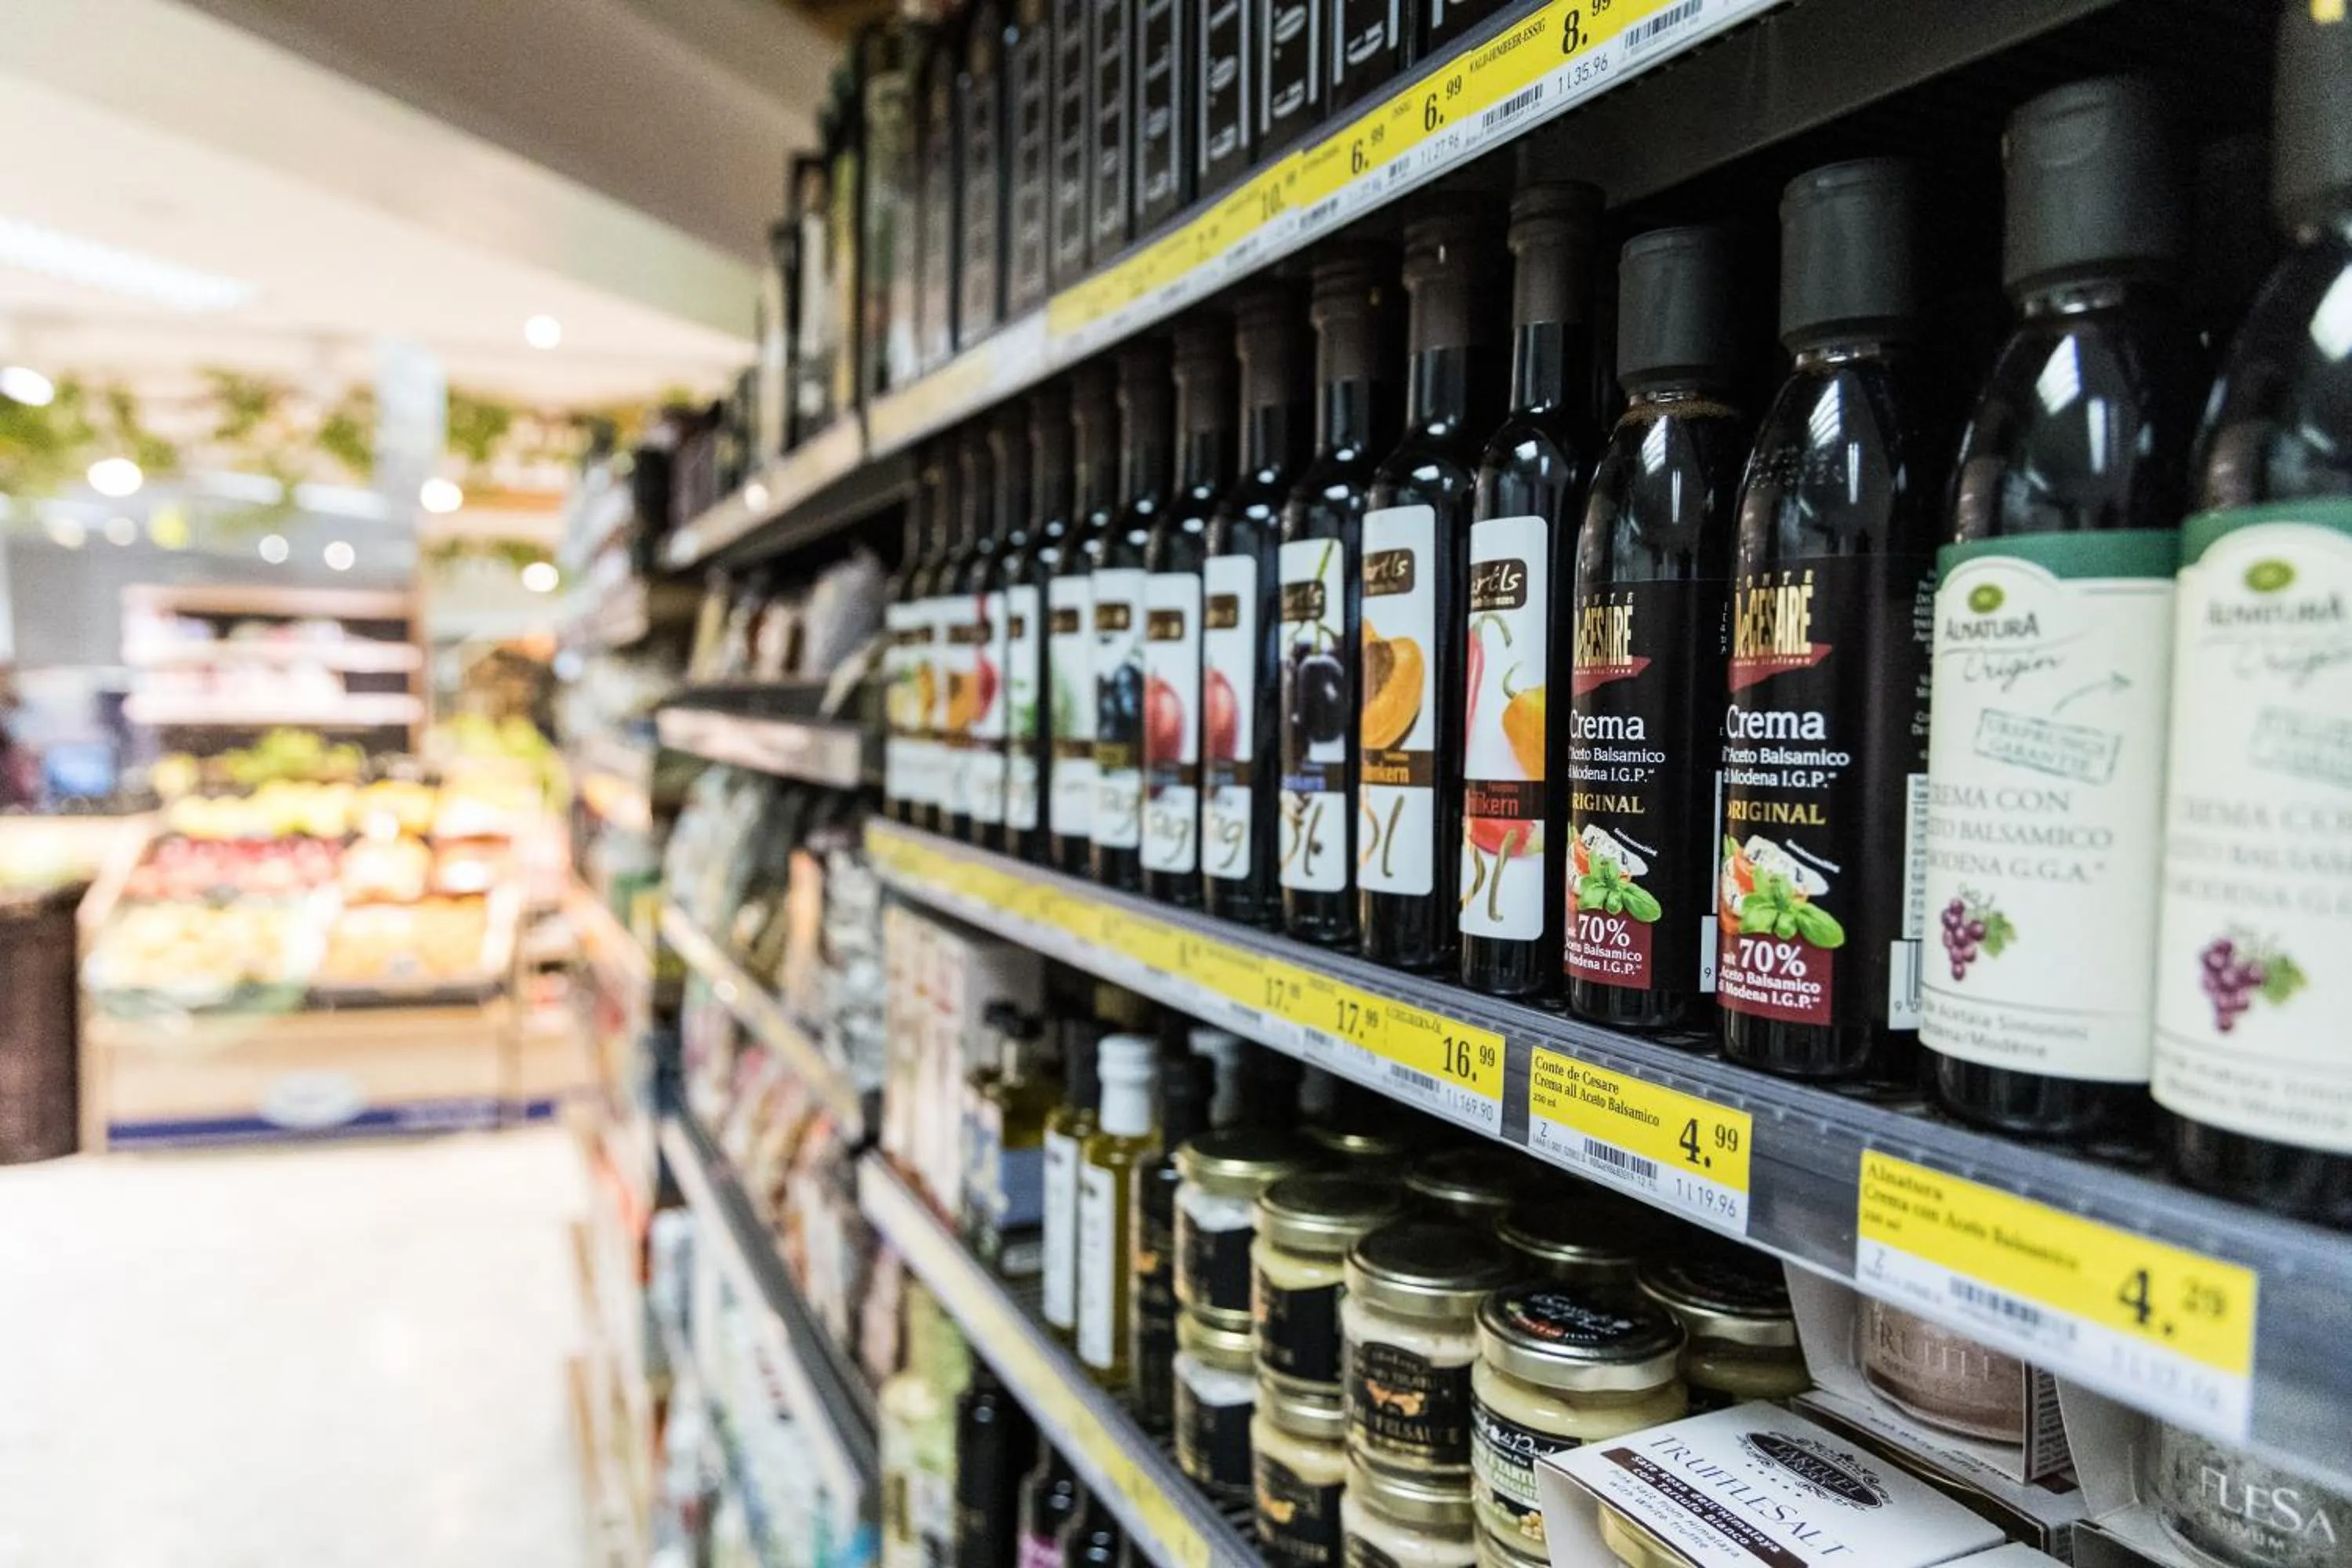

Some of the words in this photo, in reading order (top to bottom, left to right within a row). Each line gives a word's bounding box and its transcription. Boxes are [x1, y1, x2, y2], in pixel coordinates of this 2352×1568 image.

[1569, 709, 1646, 740] Crema
[1726, 704, 1826, 740] Crema
[1594, 746, 1665, 763] Balsamico
[1759, 746, 1850, 766] Balsamico
[1730, 768, 1778, 786] Modena
[1572, 793, 1645, 813] RIGINAL
[1578, 914, 1631, 946] 70%
[1584, 943, 1642, 962] Balsamico
[1739, 939, 1806, 976] 70%
[1747, 971, 1820, 993] Balsamico
[1534, 1055, 1565, 1076] Conte
[1567, 1066, 1580, 1081] de
[1582, 1071, 1620, 1096] Cesare
[1534, 1072, 1563, 1094] Crema
[1578, 1089, 1606, 1109] Aceto
[1608, 1098, 1661, 1127] Balsamico
[1633, 1468, 1656, 1483] con
[1657, 1482, 1703, 1514] Tartufo
[1704, 1513, 1751, 1545] Bianco
